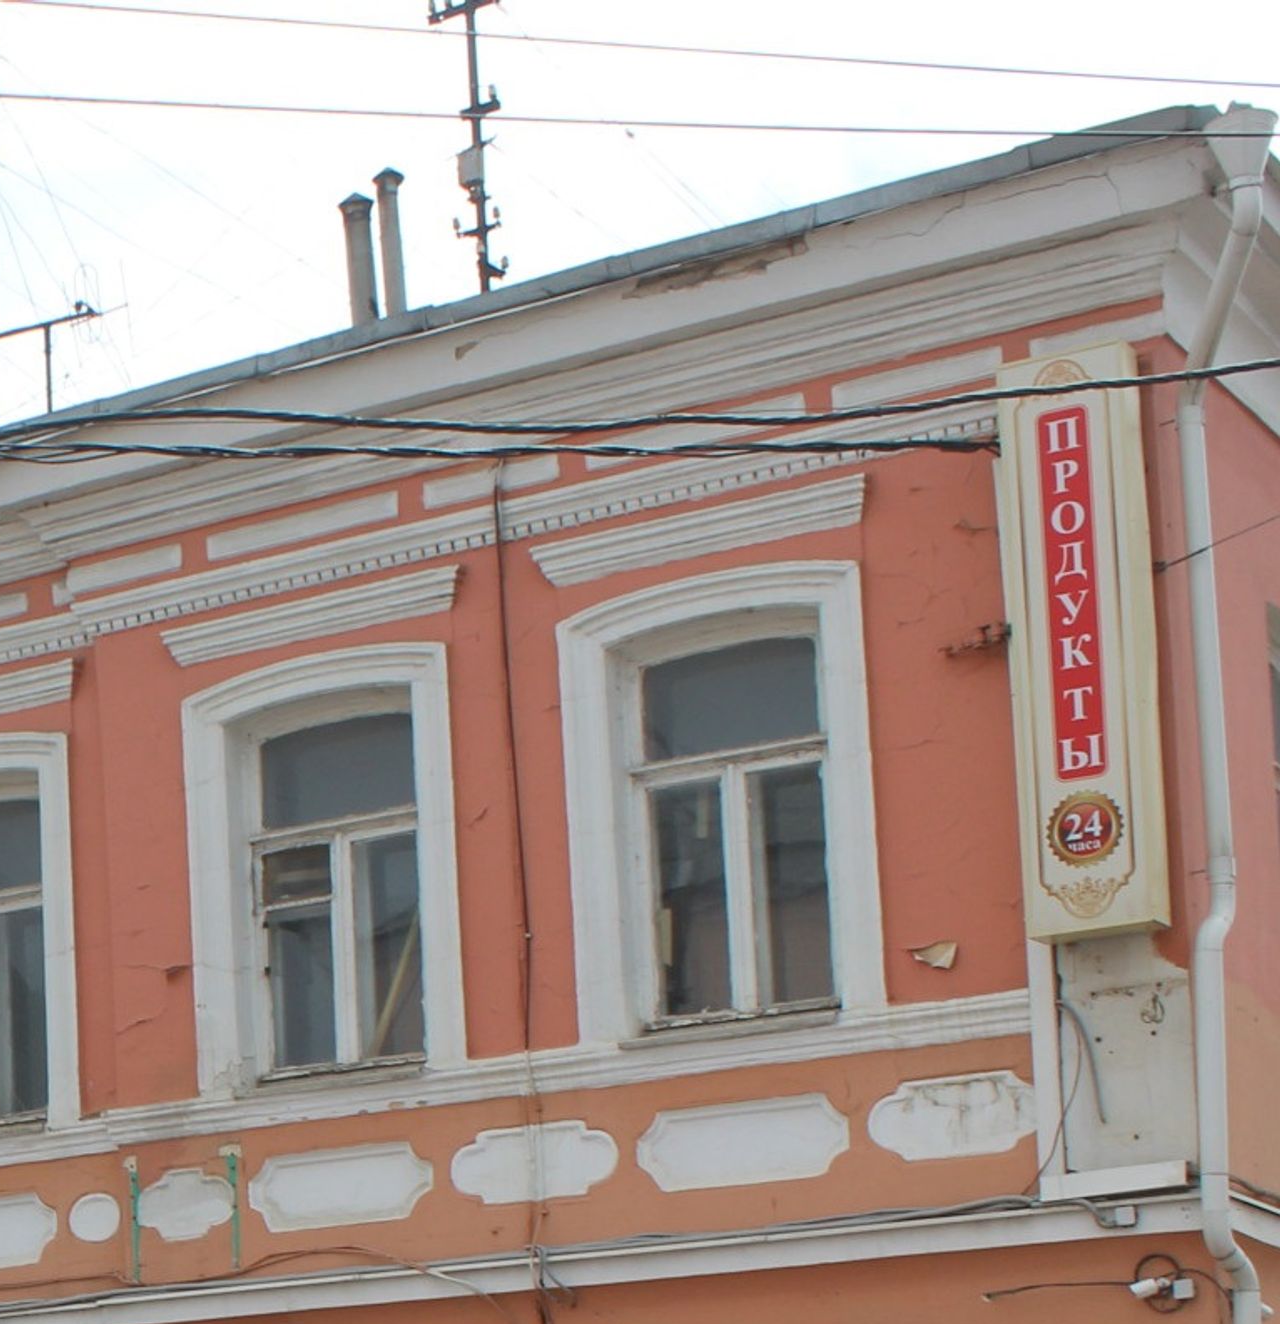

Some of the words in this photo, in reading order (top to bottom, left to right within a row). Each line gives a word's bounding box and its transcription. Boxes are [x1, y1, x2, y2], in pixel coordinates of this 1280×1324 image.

[1044, 415, 1104, 773] ПРОДУКТЫ
[1064, 810, 1104, 841] 24
[1067, 839, 1102, 852] часа
